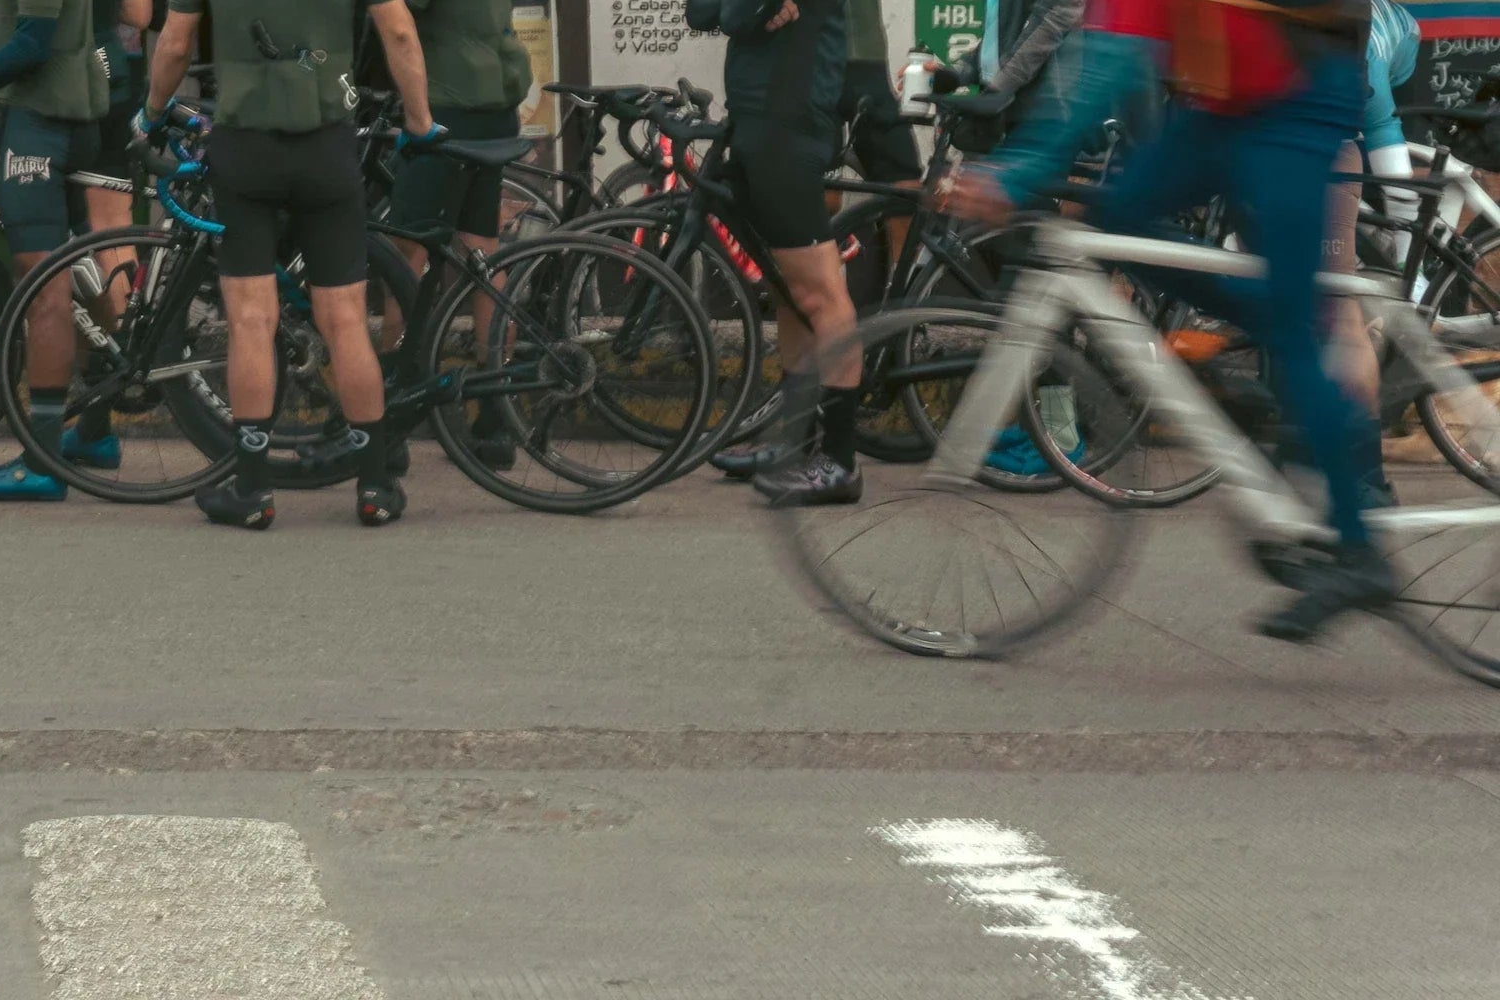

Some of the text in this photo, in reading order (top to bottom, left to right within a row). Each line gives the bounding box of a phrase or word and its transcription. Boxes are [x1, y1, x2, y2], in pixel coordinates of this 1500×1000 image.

[613, 13, 655, 26] Zona
[931, 4, 983, 27] HBL
[631, 39, 679, 54] Video
